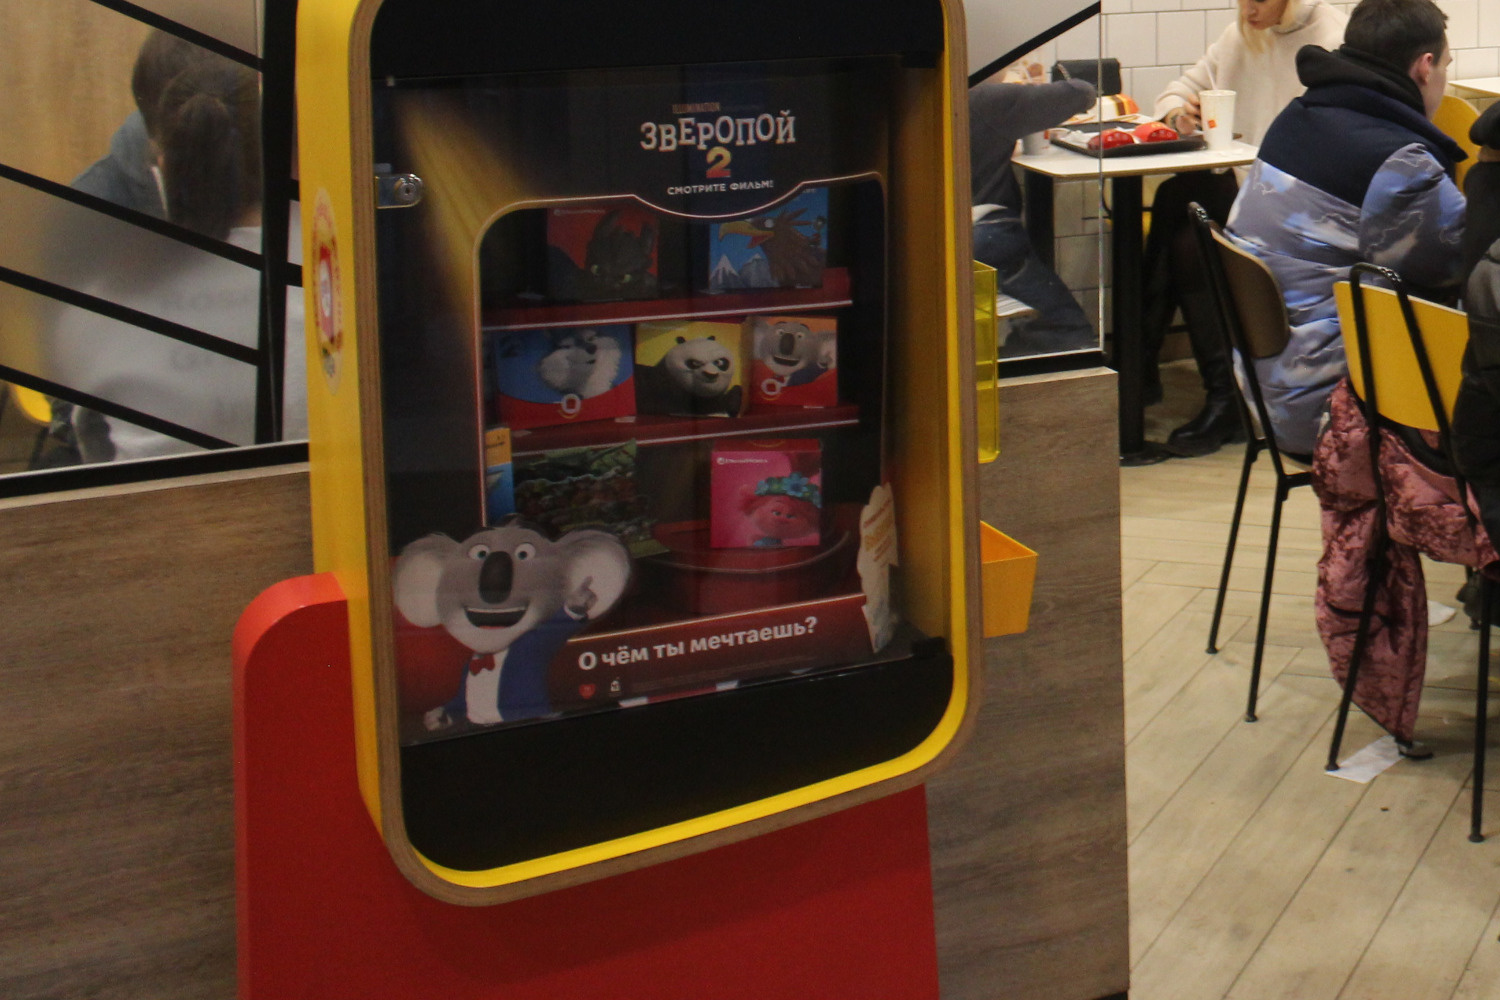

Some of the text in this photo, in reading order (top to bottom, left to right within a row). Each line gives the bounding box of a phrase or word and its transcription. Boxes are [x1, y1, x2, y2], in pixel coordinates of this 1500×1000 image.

[639, 109, 797, 152] ЗВЕРОПОЙ
[705, 145, 732, 179] 2
[667, 179, 775, 196] СМОТРИТЕ ФИЛЬМ!
[578, 615, 818, 671] О чём ты мечтаешь?
